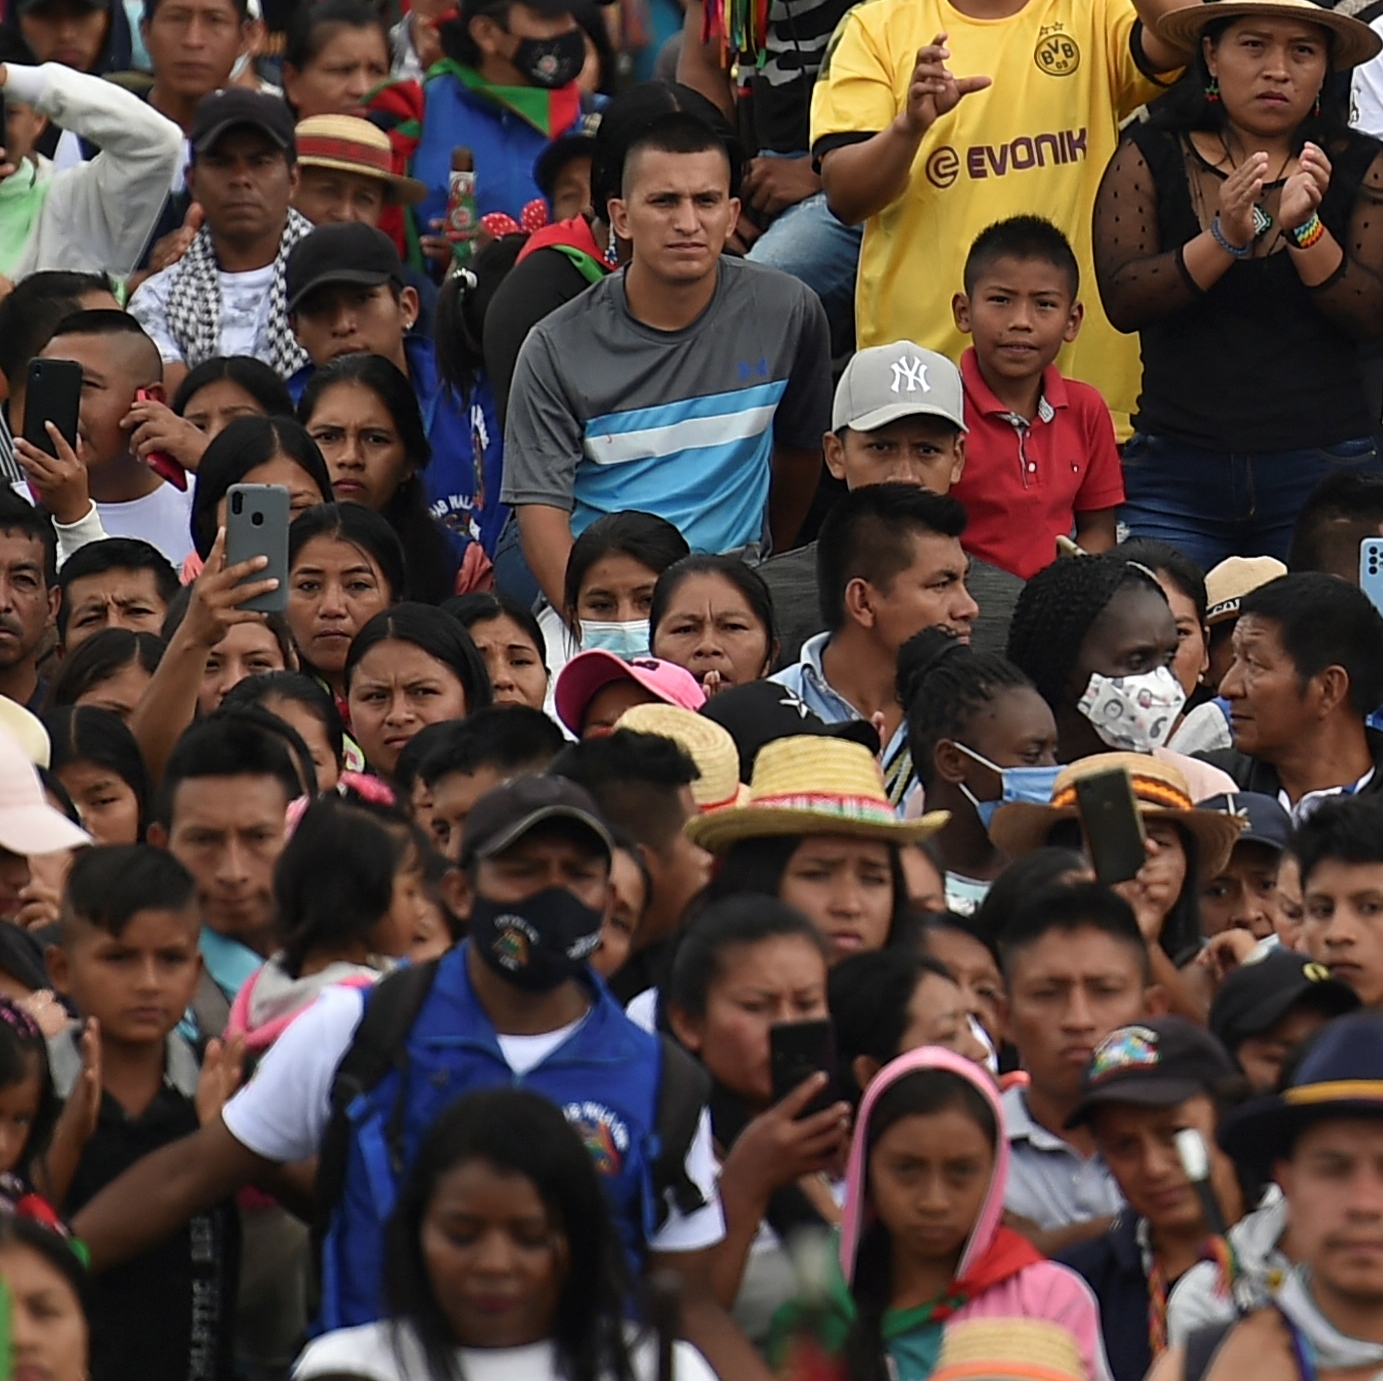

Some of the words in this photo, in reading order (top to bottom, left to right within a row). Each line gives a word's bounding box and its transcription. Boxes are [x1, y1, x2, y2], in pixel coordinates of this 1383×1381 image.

[1040, 39, 1075, 66] BVB
[967, 127, 1088, 180] EVONIK
[890, 355, 930, 394] NY
